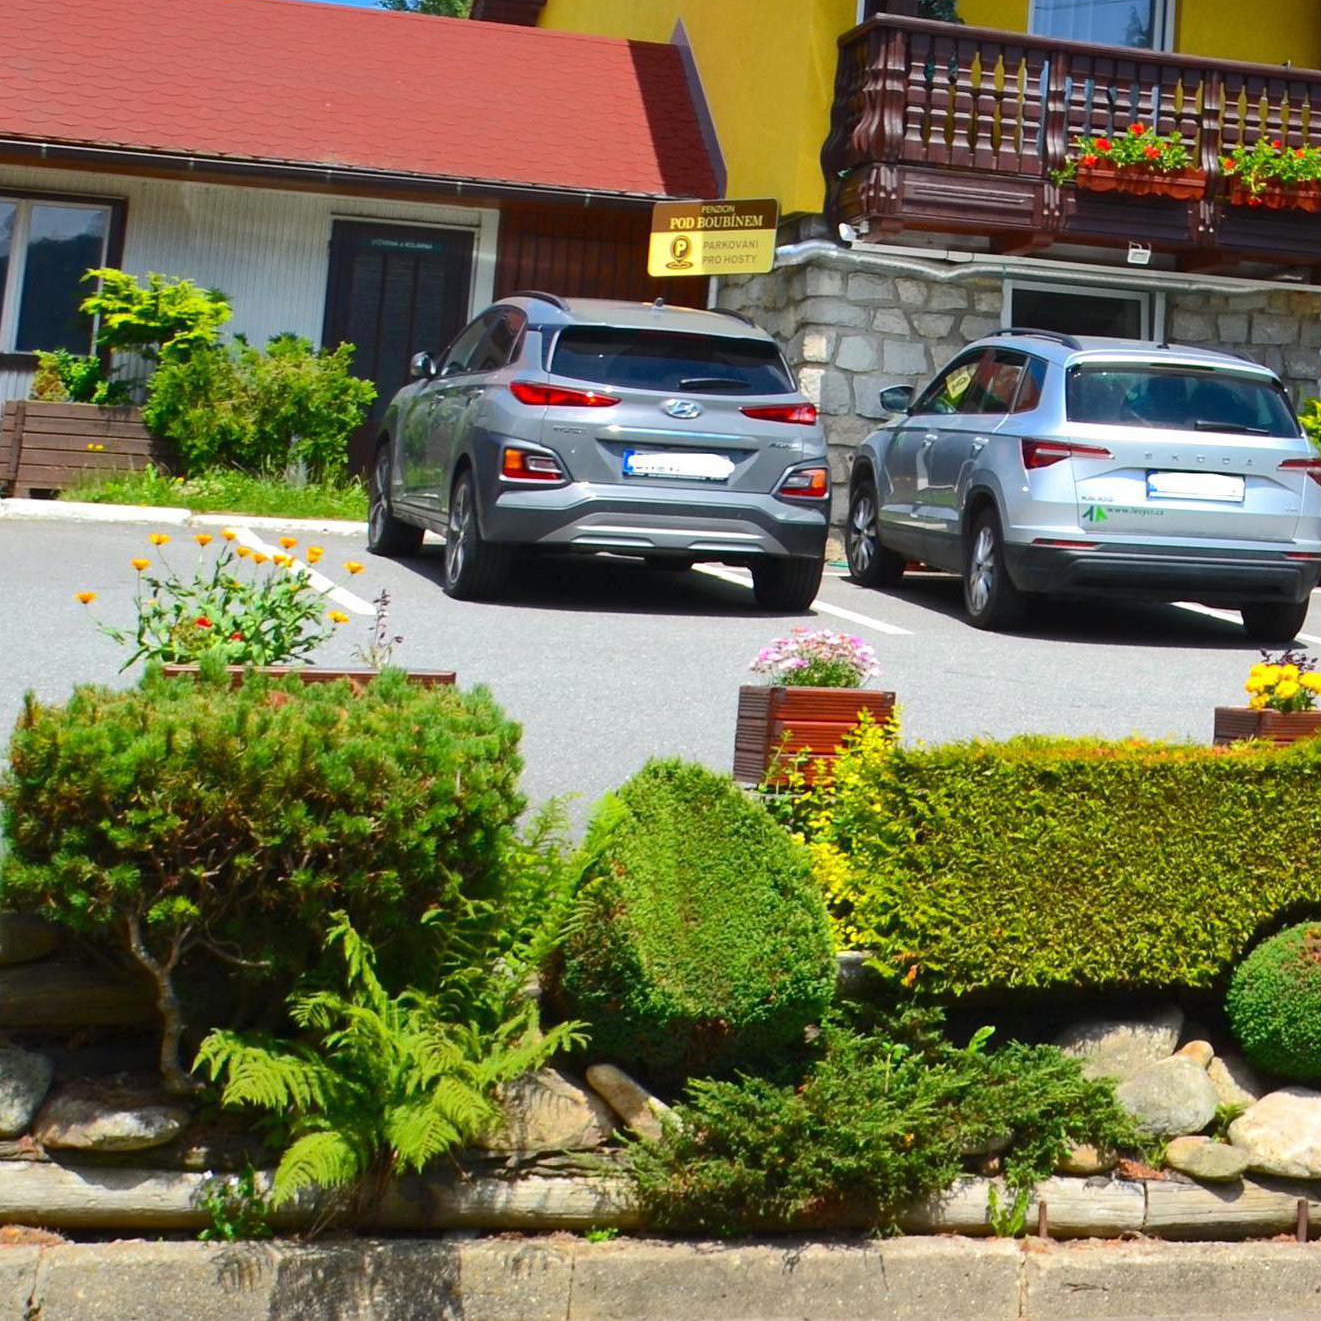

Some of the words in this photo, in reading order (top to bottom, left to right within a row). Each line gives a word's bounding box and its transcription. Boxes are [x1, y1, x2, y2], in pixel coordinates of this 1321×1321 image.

[701, 205, 735, 214] PENZION
[670, 217, 696, 229] POD
[697, 213, 763, 228] BOUBÍNEM
[702, 254, 721, 264] PRO
[724, 253, 757, 264] HOSTY
